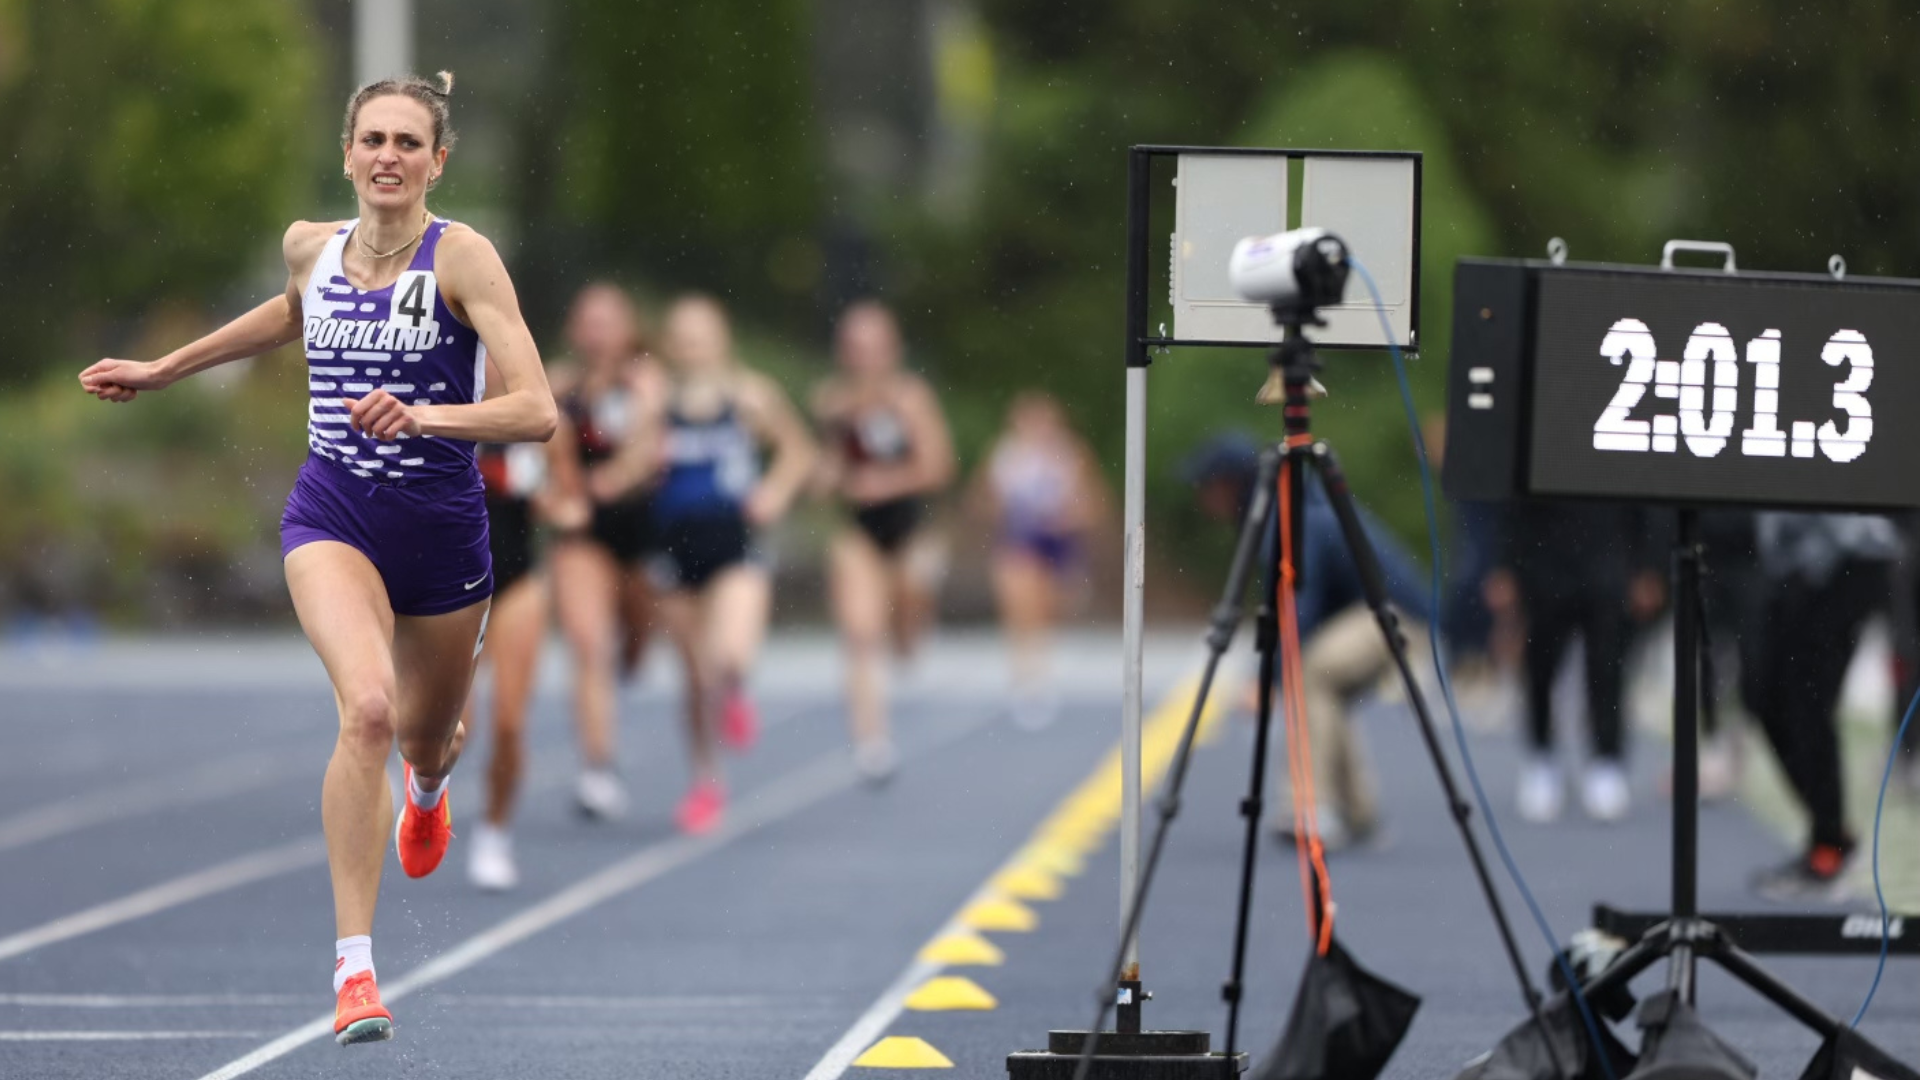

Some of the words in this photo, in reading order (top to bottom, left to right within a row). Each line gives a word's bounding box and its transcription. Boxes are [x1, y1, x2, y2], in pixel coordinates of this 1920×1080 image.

[398, 274, 427, 327] 4
[305, 316, 441, 352] PORTLAND
[1594, 318, 1874, 463] 2:01.3
